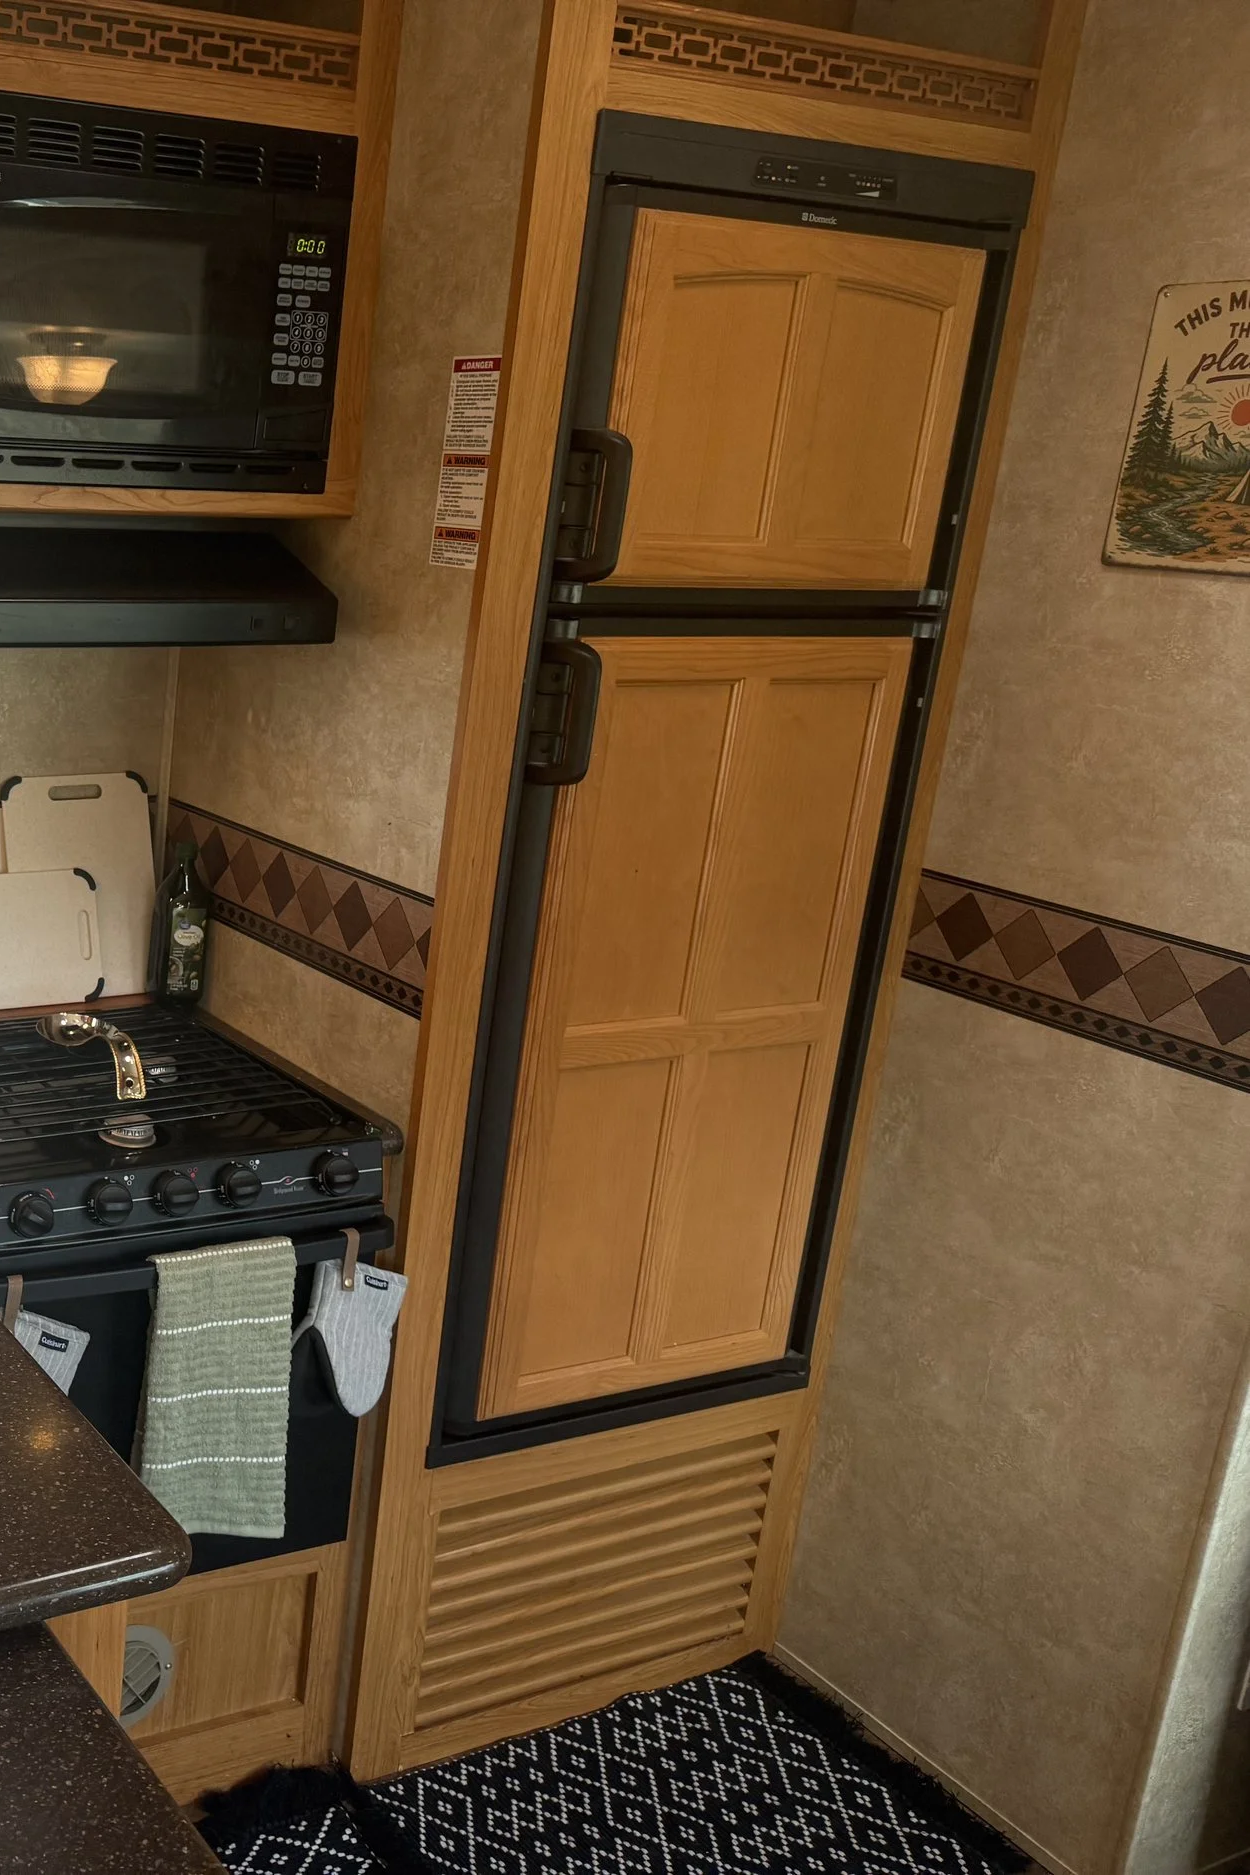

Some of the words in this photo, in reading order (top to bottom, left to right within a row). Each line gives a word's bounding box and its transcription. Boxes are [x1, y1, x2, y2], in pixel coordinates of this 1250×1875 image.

[296, 238, 326, 254] 0:00
[1174, 297, 1223, 337] THIS
[1229, 289, 1250, 312] M
[466, 360, 494, 370] DANGER
[453, 455, 486, 467] WARNING
[444, 529, 477, 541] WARNING
[41, 1336, 66, 1349] Cuisinart
